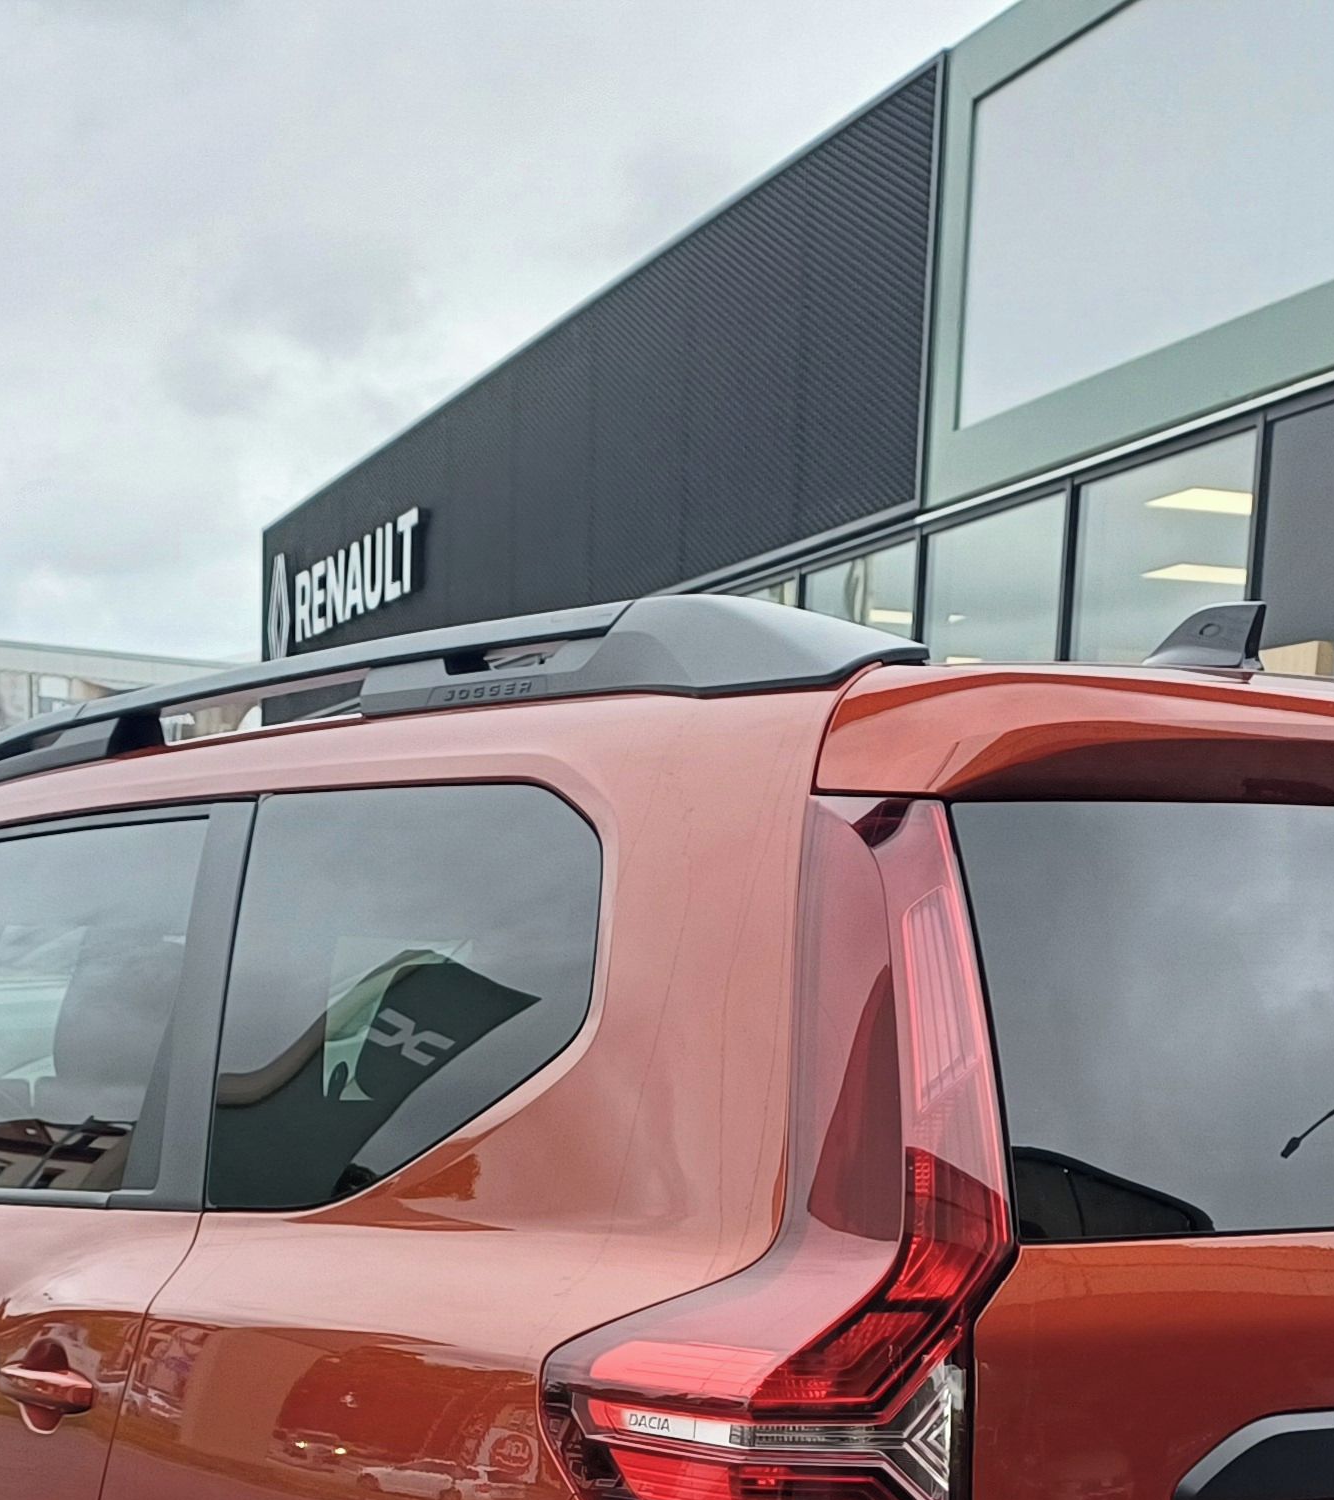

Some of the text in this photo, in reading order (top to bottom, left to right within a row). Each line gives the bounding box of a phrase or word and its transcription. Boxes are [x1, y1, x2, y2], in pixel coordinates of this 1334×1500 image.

[295, 507, 419, 643] RENAULT
[444, 682, 532, 702] JOGGER
[628, 1413, 670, 1432] DACIA
